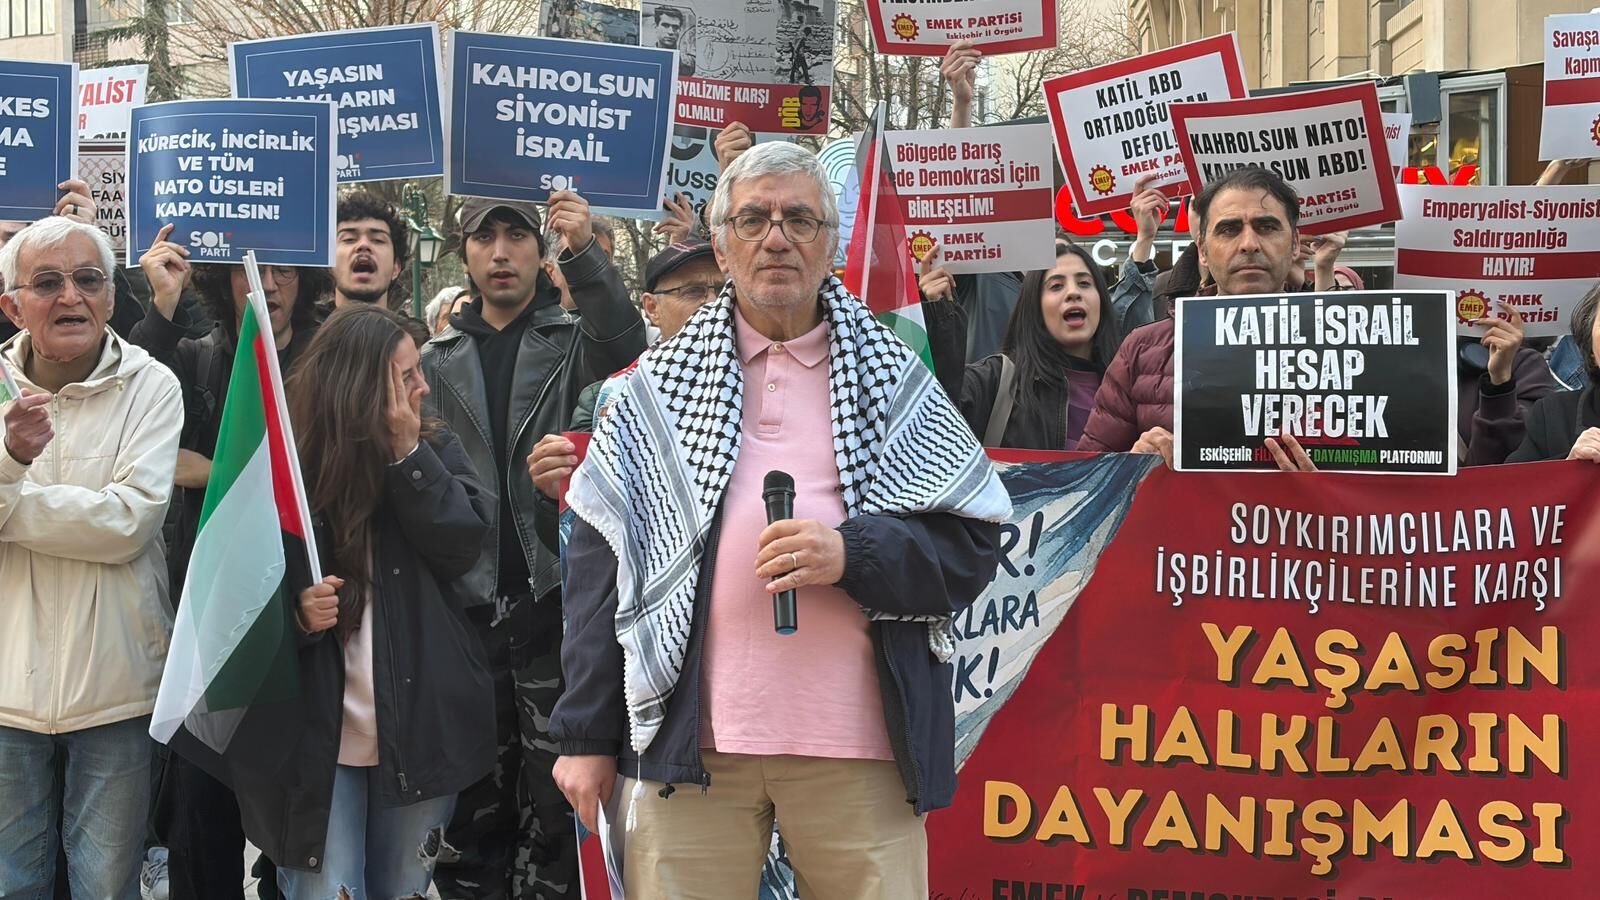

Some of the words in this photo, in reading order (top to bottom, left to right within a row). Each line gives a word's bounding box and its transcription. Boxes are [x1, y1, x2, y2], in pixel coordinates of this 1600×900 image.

[925, 18, 963, 30] EMEK
[967, 12, 1023, 28] PARTİSİ
[946, 30, 982, 41] Eskişehir
[1553, 29, 1600, 52] Savaşa
[282, 63, 384, 90] YAŞASIN
[472, 63, 655, 100] KAHROLSUN
[734, 86, 770, 109] KARŞI
[1096, 77, 1144, 109] KATİL
[1149, 70, 1183, 97] ABD
[495, 92, 632, 131] SİYONİST
[678, 103, 725, 124] OLMALI!
[138, 128, 217, 154] KÜRECİK,
[222, 128, 315, 152] İNCİRLİK
[515, 127, 610, 163] İSRAİL
[1189, 126, 1299, 155] KAHROLSUN
[1304, 116, 1367, 147] NATO!
[178, 156, 202, 172] VE
[208, 153, 255, 173] TÜM
[897, 142, 957, 164] Bölgede
[961, 141, 1002, 165] Barış
[1317, 149, 1368, 178] ABD!
[919, 164, 1005, 187] Demokrasi
[1009, 160, 1041, 189] İçin
[1121, 157, 1160, 177] EMEK
[154, 178, 203, 196] NATO
[209, 175, 285, 197] ÜSLERİ
[539, 174, 578, 193] SOL
[155, 201, 281, 220] KAPATILSIN!
[908, 194, 995, 224] BİRLEŞELİM!
[1422, 198, 1600, 222] Emperyalist-Siyonist
[190, 231, 231, 248] SOL
[943, 232, 985, 245] EMEK
[1453, 227, 1568, 250] Saldırganlığa
[200, 247, 231, 257] PARTİ
[944, 245, 1002, 262] PARTİSİ
[1482, 257, 1536, 276] HAYIR!
[1460, 302, 1484, 312] EMEP
[1215, 298, 1307, 346] KATİL
[1314, 297, 1420, 346] İSRAİL
[1255, 349, 1365, 391] HESAP
[1240, 393, 1390, 438] VERECEK
[1200, 446, 1252, 465] ESKİŞEHİR
[1314, 449, 1378, 467] DAYANIŞMA
[1380, 449, 1443, 465] PLATFORMU
[1230, 502, 1516, 556] SOYKIRIMCILARA
[1531, 504, 1567, 546] VE
[1157, 546, 1457, 614] İŞBİRLİKÇİLERİNE
[1474, 556, 1562, 612] KARŞI
[1200, 622, 1562, 709] YAŞASIN
[1100, 703, 1564, 774] HALKLARIN
[983, 780, 1567, 876] DAYANIŞMASI
